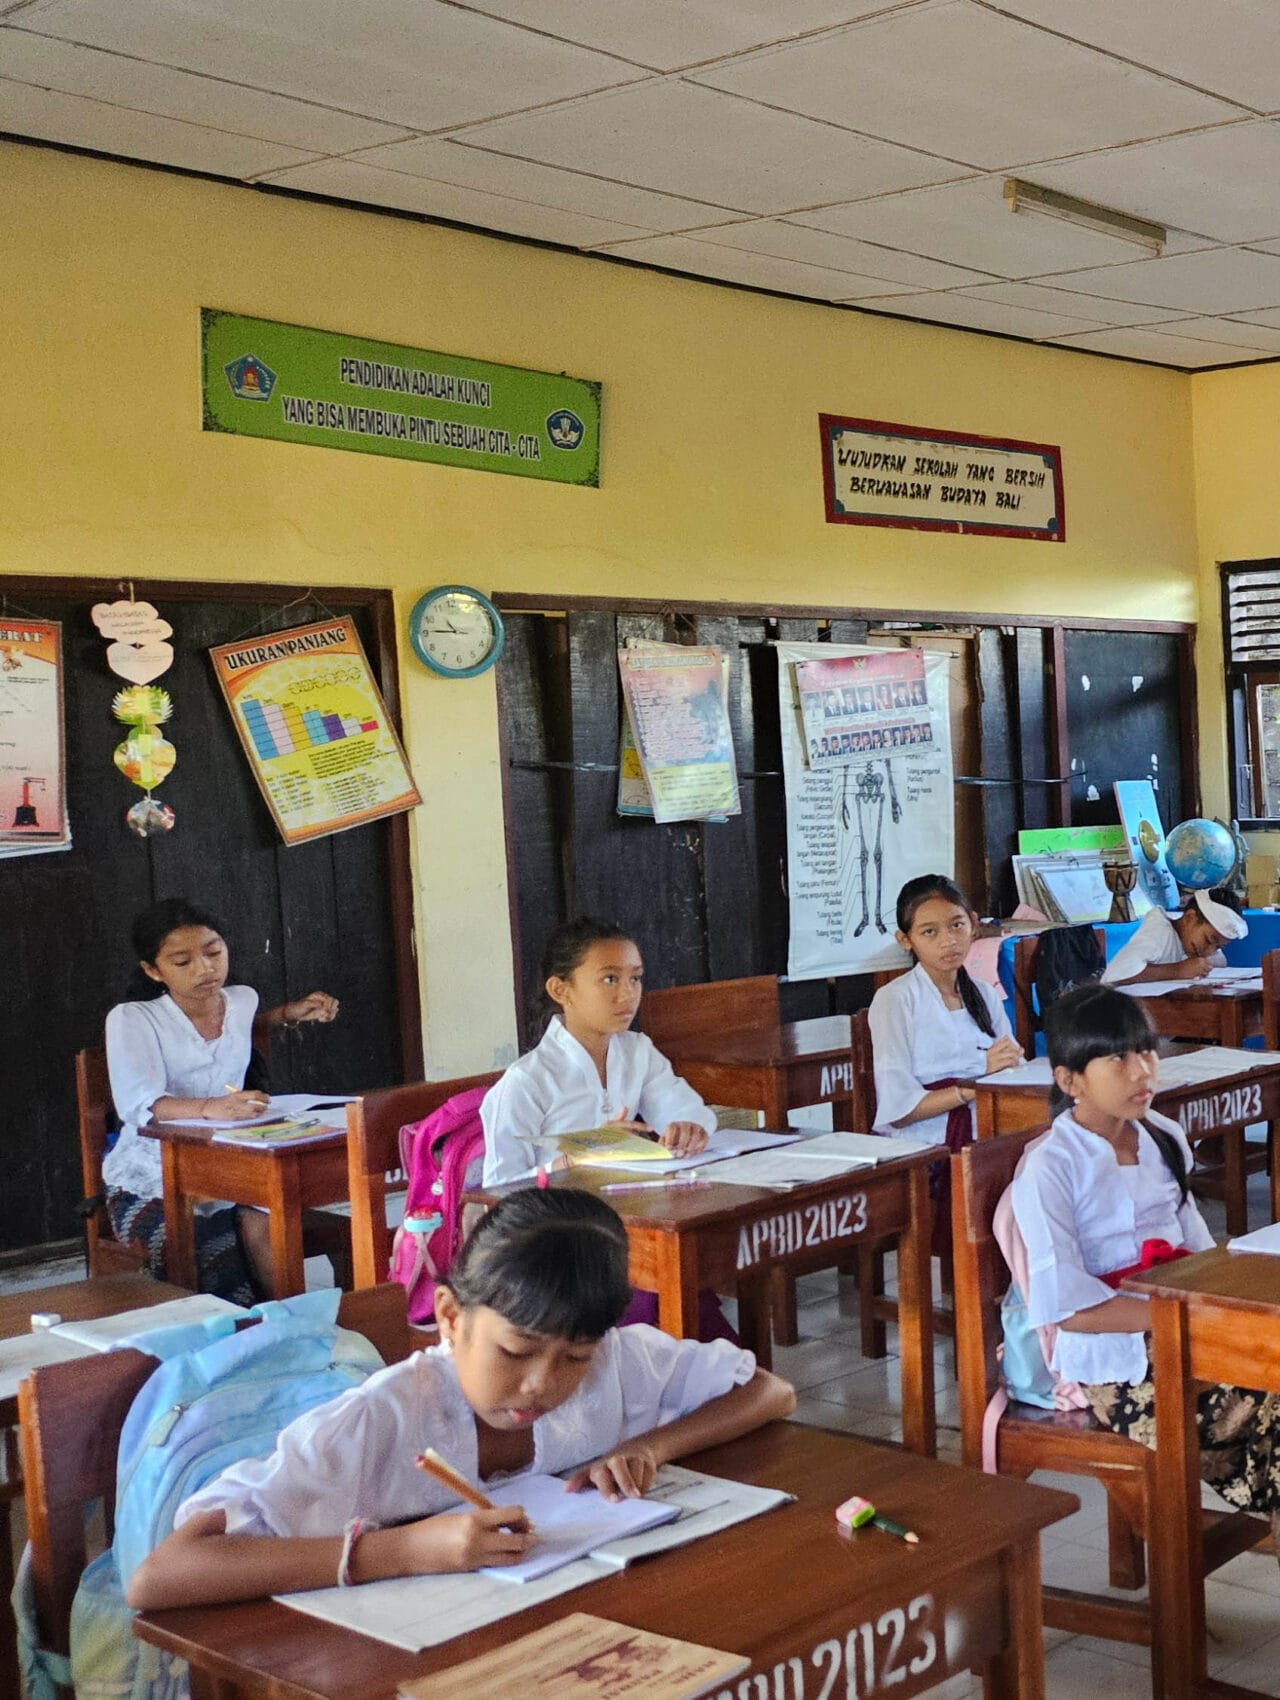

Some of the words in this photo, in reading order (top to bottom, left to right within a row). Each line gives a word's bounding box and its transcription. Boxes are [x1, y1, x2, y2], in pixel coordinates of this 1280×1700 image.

[340, 357, 409, 393] PENDIDIKAN
[412, 372, 455, 400] ADALAH
[457, 380, 491, 407] KUNCI
[282, 396, 314, 426] YANG
[317, 402, 345, 431] BISA
[347, 407, 407, 440] MEMBUKA
[409, 415, 441, 444] PINTU
[443, 421, 486, 453] SEBUAH
[488, 428, 511, 455] CITA
[518, 433, 541, 460] CITA
[837, 448, 906, 474] WUJUDKAN
[913, 457, 958, 479] SEKOLAH
[966, 463, 995, 483] YANG
[1005, 467, 1046, 489] BERSIH
[850, 476, 932, 501] BERWAWASAN
[941, 486, 987, 507] BUDAYA
[995, 492, 1021, 510] BALI
[226, 643, 286, 670] UKURAN
[287, 628, 347, 654] PANJANG
[422, 629, 429, 637] 9
[441, 652, 447, 660] 7
[456, 655, 462, 663] 6
